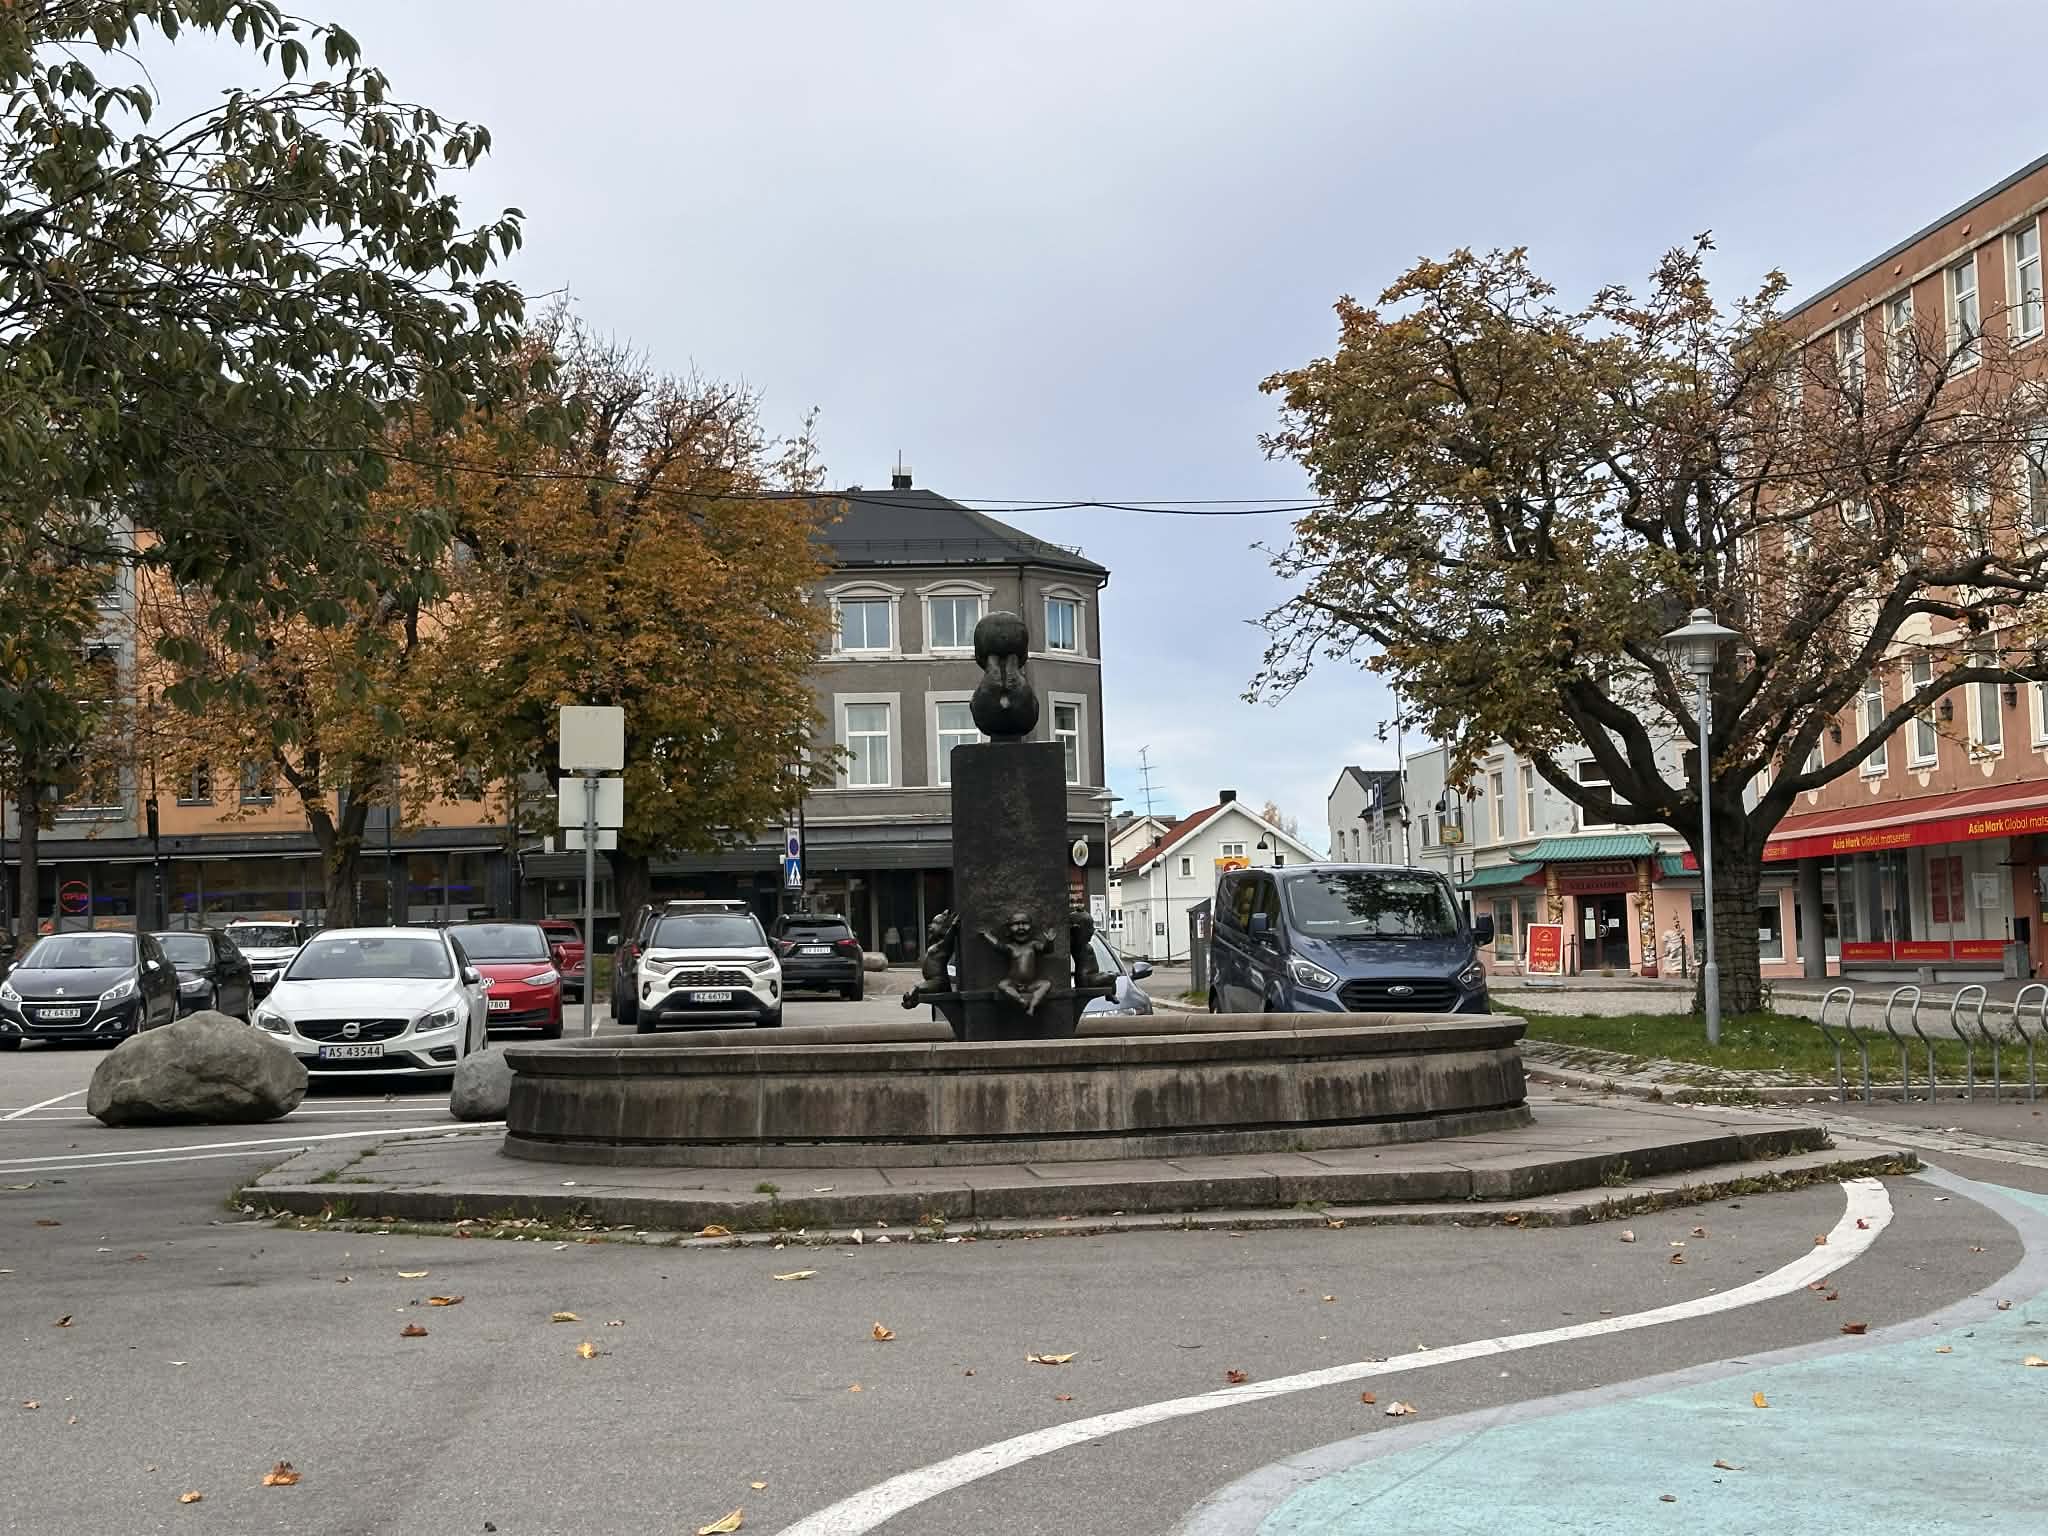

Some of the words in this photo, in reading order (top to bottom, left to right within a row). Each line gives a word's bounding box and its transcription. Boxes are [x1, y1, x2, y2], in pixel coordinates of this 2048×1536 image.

[1968, 822, 1985, 834] Asia
[1985, 819, 2004, 833] Mark
[2004, 816, 2028, 830] Global
[1832, 839, 1846, 849] Asia
[1846, 836, 1861, 848] Mark
[1861, 833, 1880, 847] Global
[329, 1047, 343, 1058] AS
[346, 1046, 381, 1057] 43544
